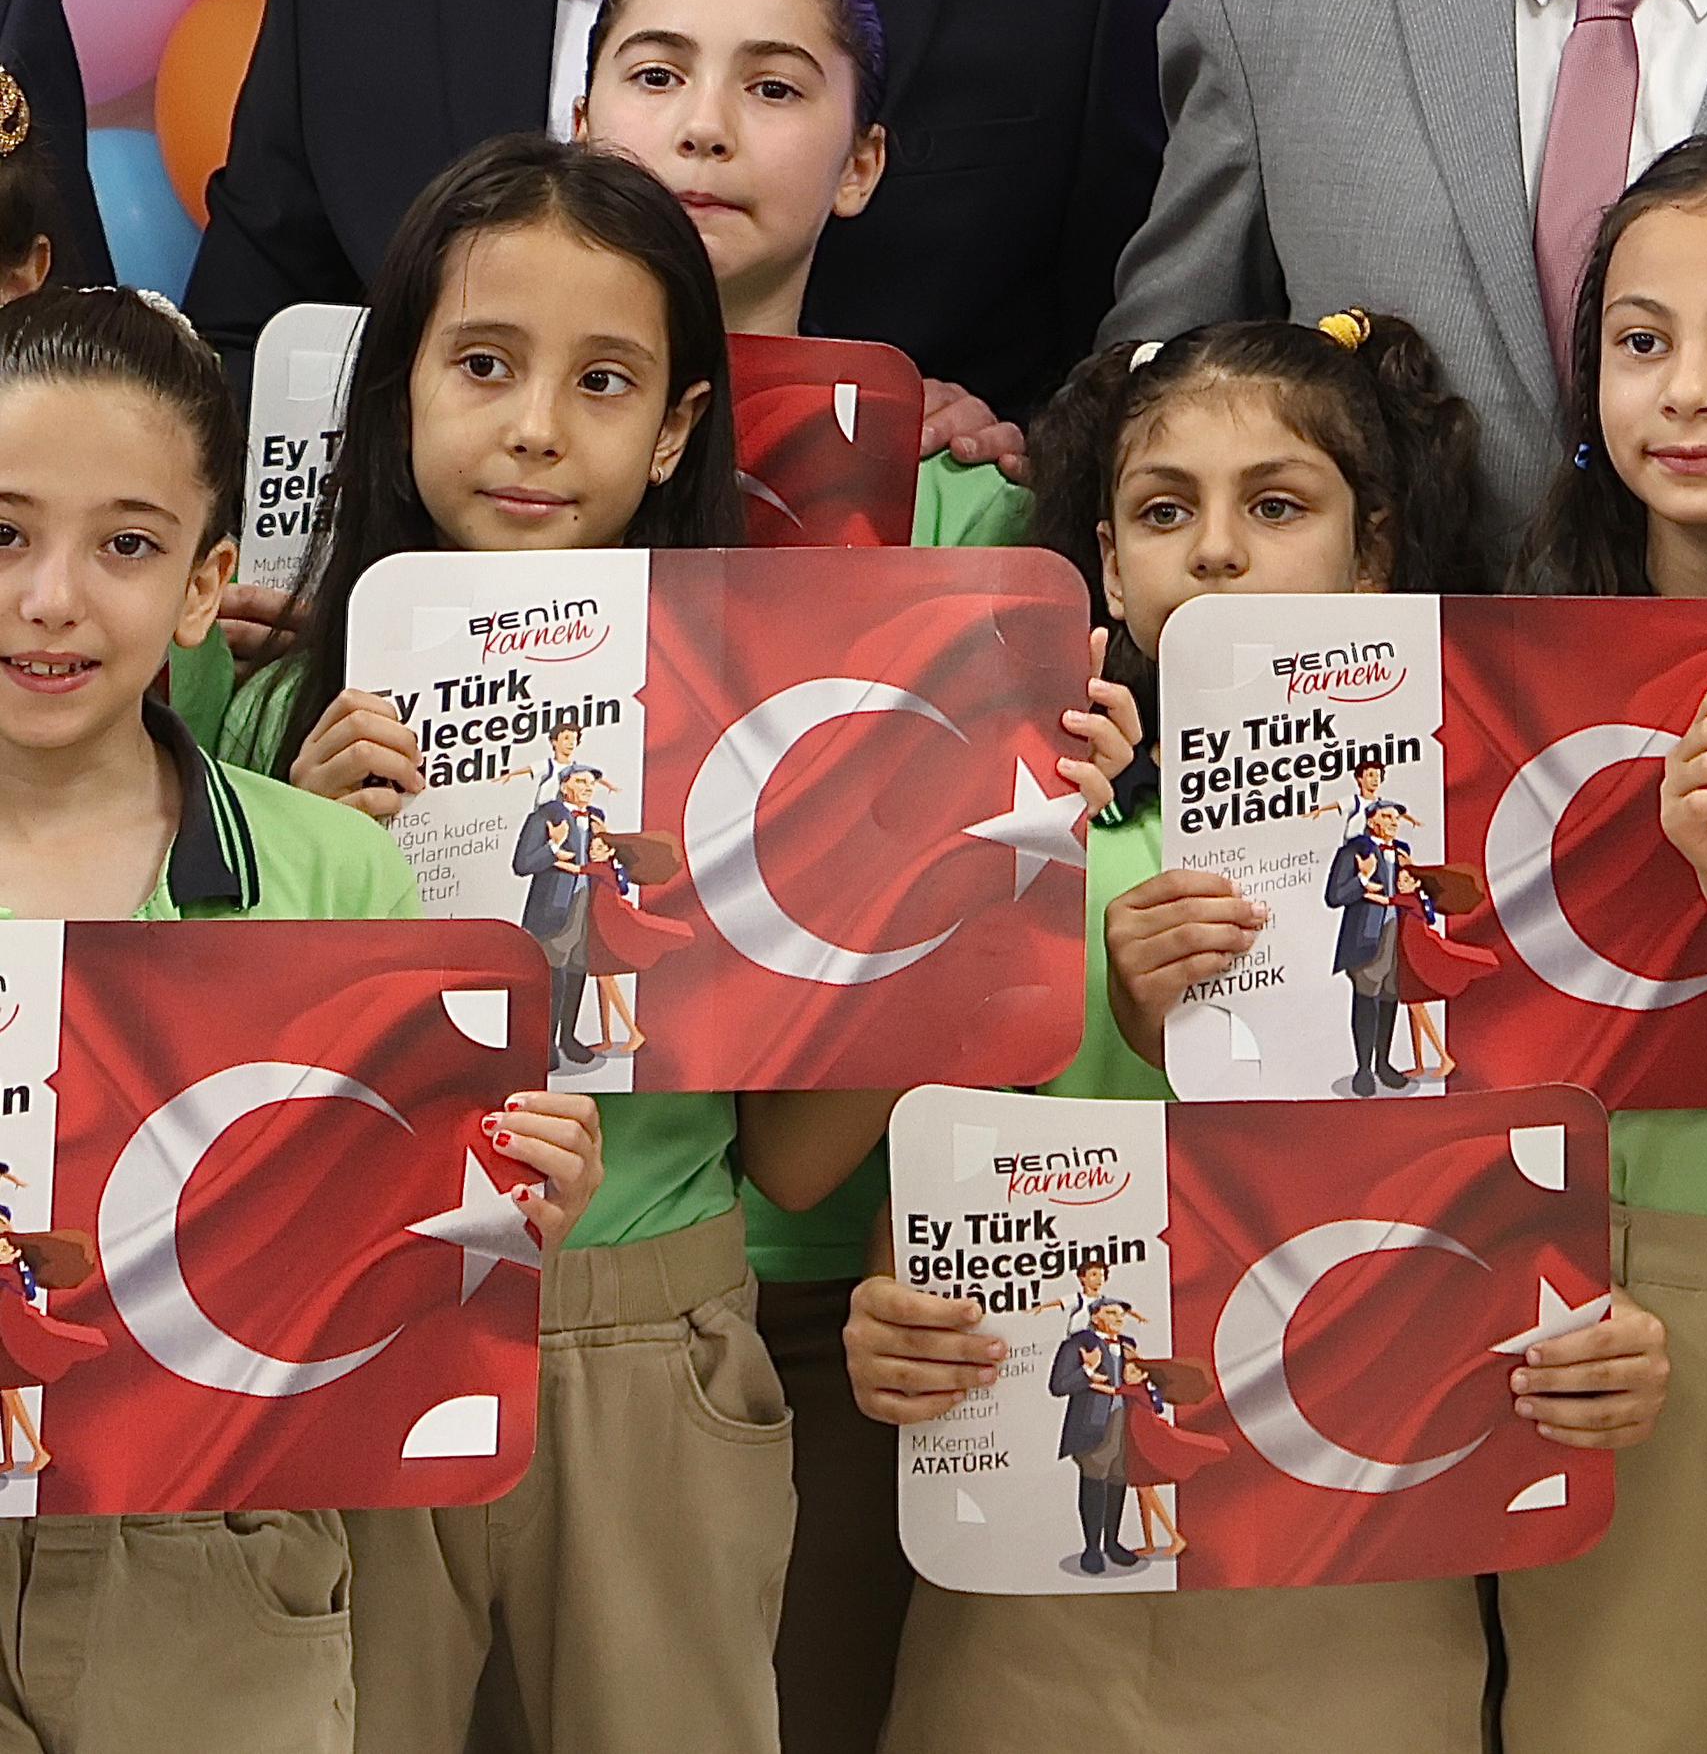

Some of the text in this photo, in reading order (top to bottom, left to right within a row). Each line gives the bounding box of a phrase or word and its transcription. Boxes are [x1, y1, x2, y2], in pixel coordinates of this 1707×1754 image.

[263, 435, 308, 471] Ey
[253, 556, 300, 572] Muhta
[482, 611, 594, 664] karnem
[434, 668, 532, 713] Türk
[1287, 652, 1391, 704] karnem
[421, 694, 620, 752] leceğinin
[1181, 708, 1336, 764] Ey Türk
[1180, 733, 1421, 804] geleceğinin
[1180, 781, 1319, 834] evlâdı!
[404, 835, 499, 865] arlarındaki
[1182, 847, 1246, 870] Muhtaç
[1183, 965, 1285, 1004] ATATÜRK
[1008, 1153, 1115, 1204] karnem
[908, 1210, 1057, 1251] Ey Türk
[908, 1235, 1146, 1285] geleceğinin
[912, 1431, 995, 1453] M.Kemal
[912, 1451, 1010, 1474] ATATÜRK
